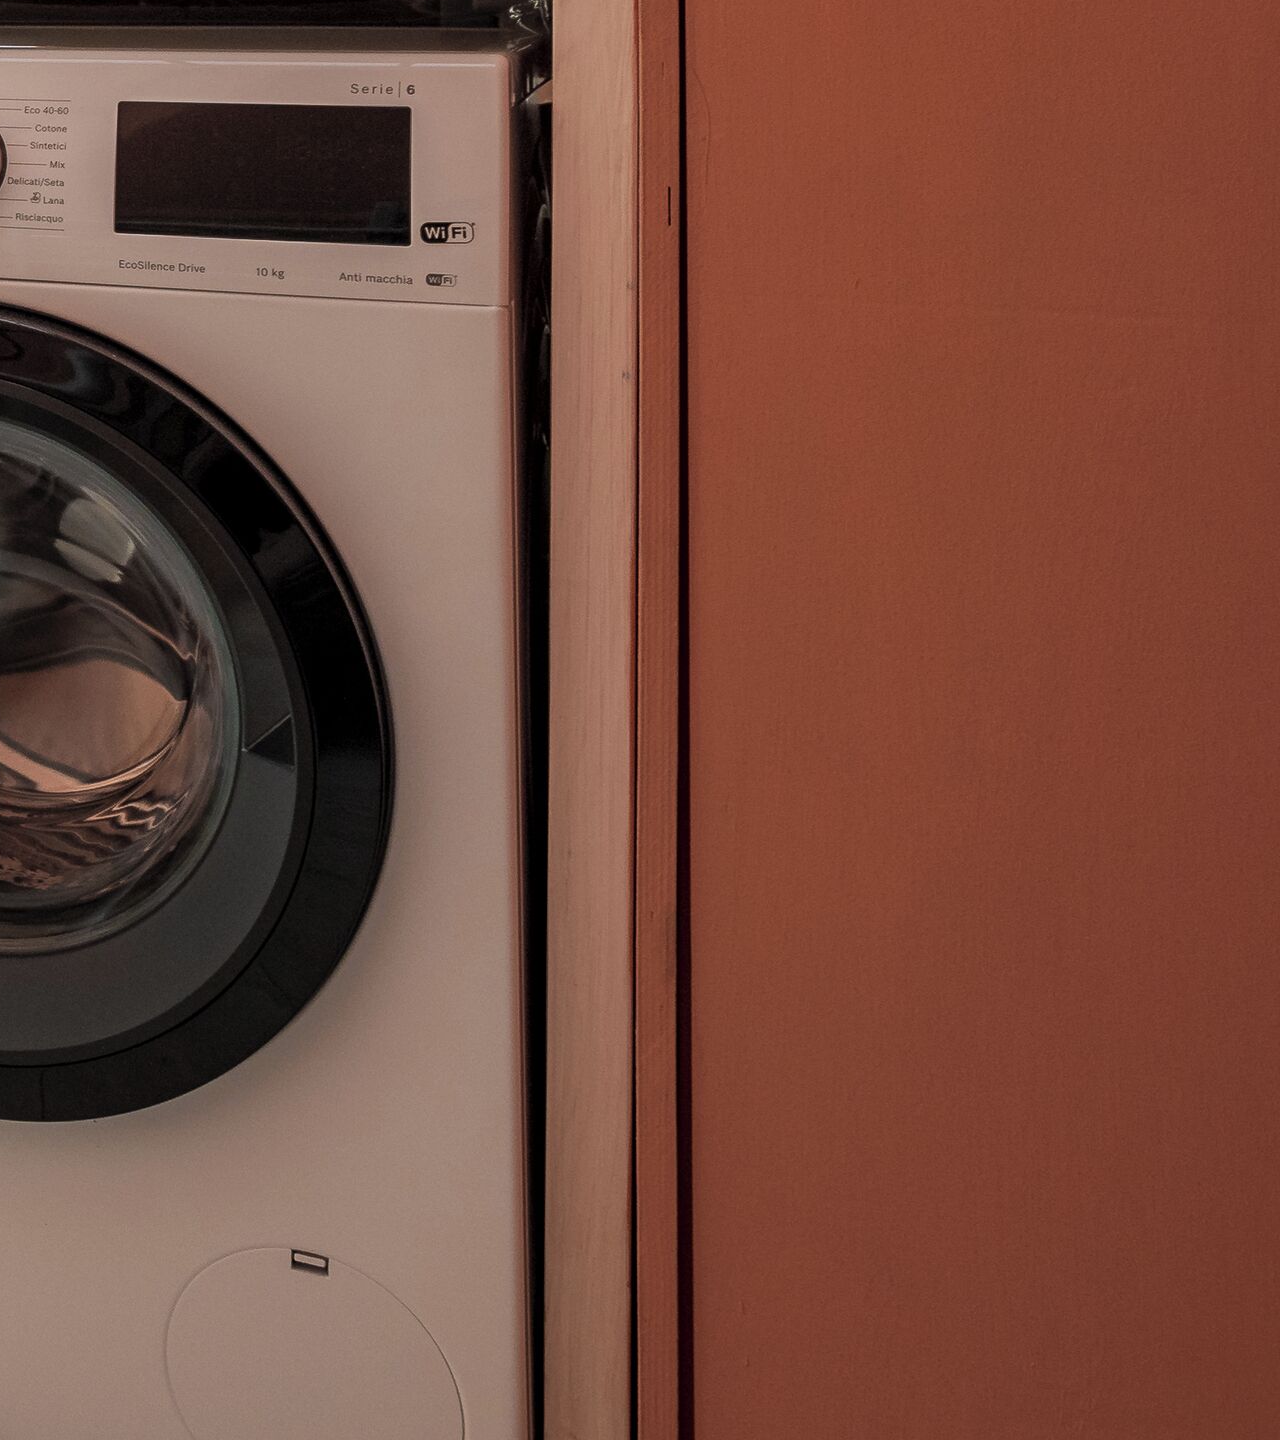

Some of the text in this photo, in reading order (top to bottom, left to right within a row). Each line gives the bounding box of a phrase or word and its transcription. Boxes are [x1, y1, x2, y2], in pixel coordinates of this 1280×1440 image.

[350, 83, 416, 95] Serie 6
[24, 106, 69, 115] Eco 40-60
[35, 124, 68, 133] Cotone
[30, 141, 67, 150] Sintetici
[49, 160, 66, 169] Mix
[7, 176, 65, 187] Delicati/Seta
[43, 196, 65, 205] Lana
[15, 213, 64, 224] Risciacquo
[118, 260, 206, 274] EcoSilence Drive
[255, 267, 285, 279] 10 kg
[338, 272, 414, 285] Anti macchia
